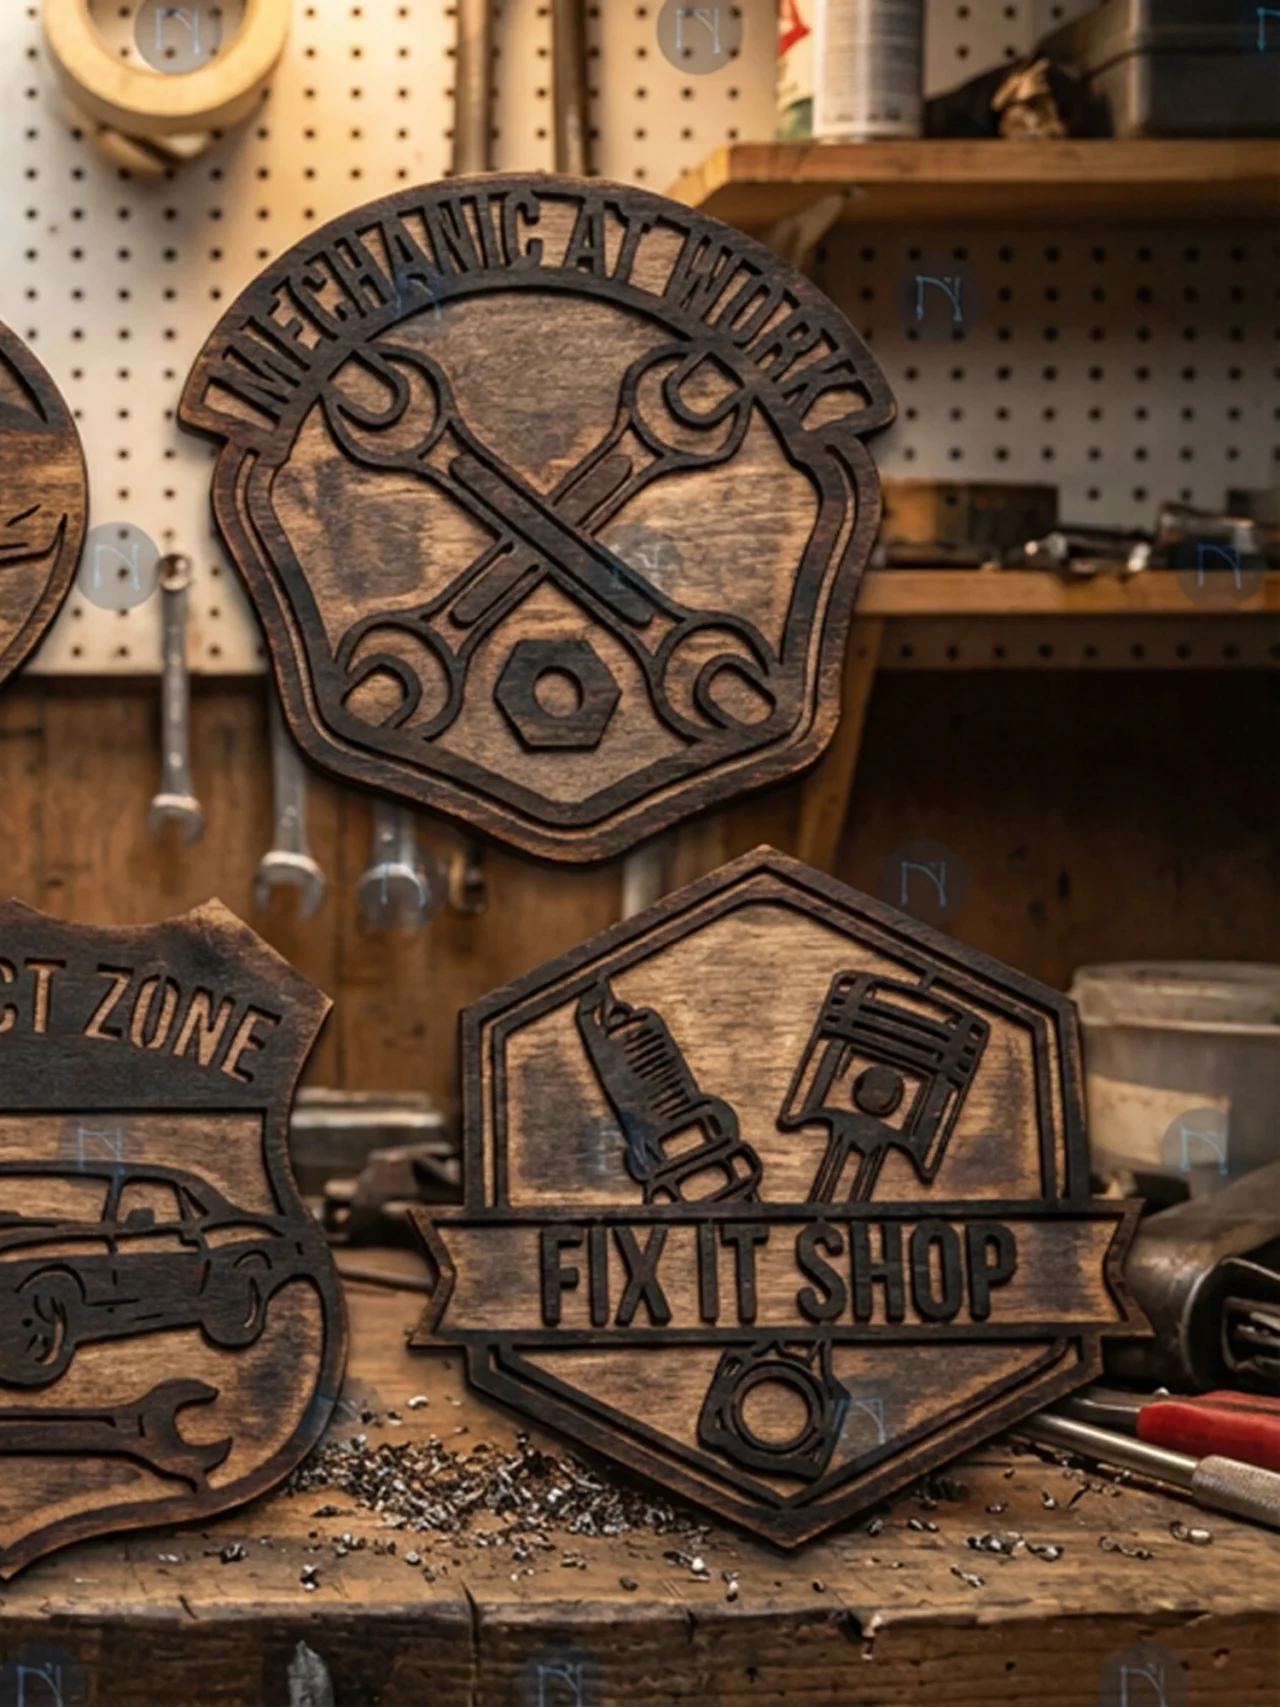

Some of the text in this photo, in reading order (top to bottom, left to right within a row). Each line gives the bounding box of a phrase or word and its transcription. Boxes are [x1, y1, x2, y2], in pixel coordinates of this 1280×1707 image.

[205, 192, 870, 424] MECHANIC AT WORK
[83, 962, 283, 1084] ZONE
[538, 1220, 1019, 1327] FIX IT SHOP
